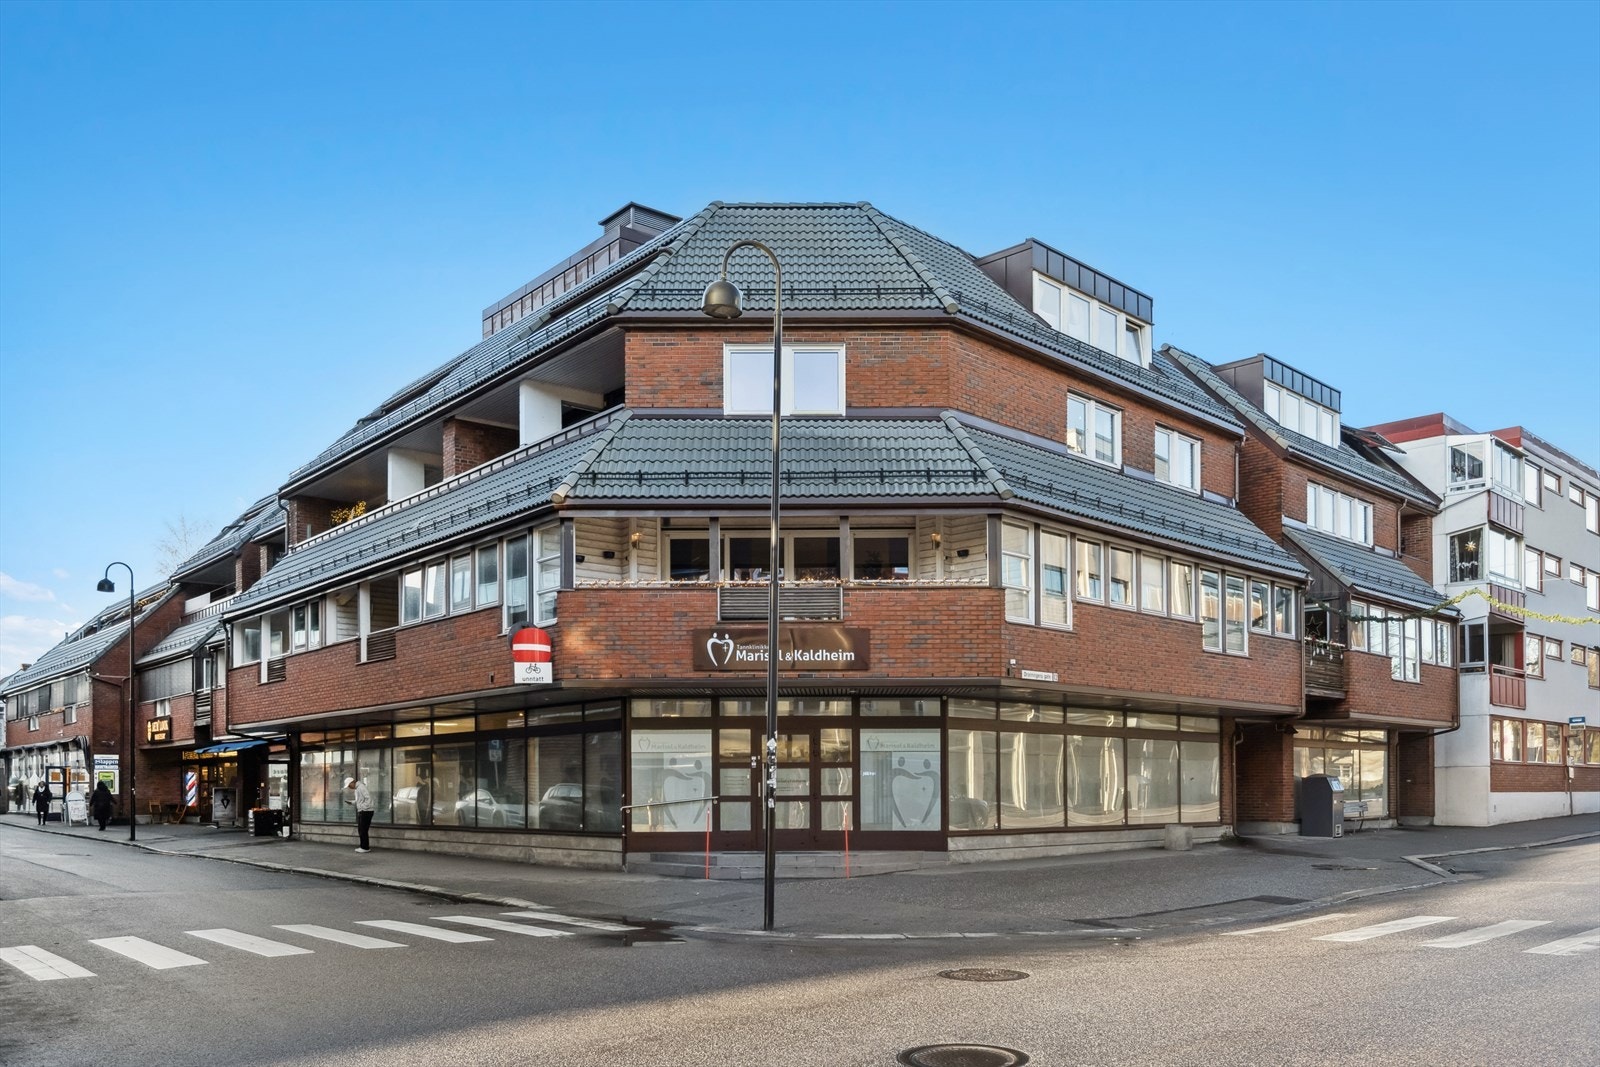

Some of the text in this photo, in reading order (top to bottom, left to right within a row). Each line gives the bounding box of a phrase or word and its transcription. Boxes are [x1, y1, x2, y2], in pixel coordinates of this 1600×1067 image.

[736, 649, 855, 662] Marisl & Kaldheim
